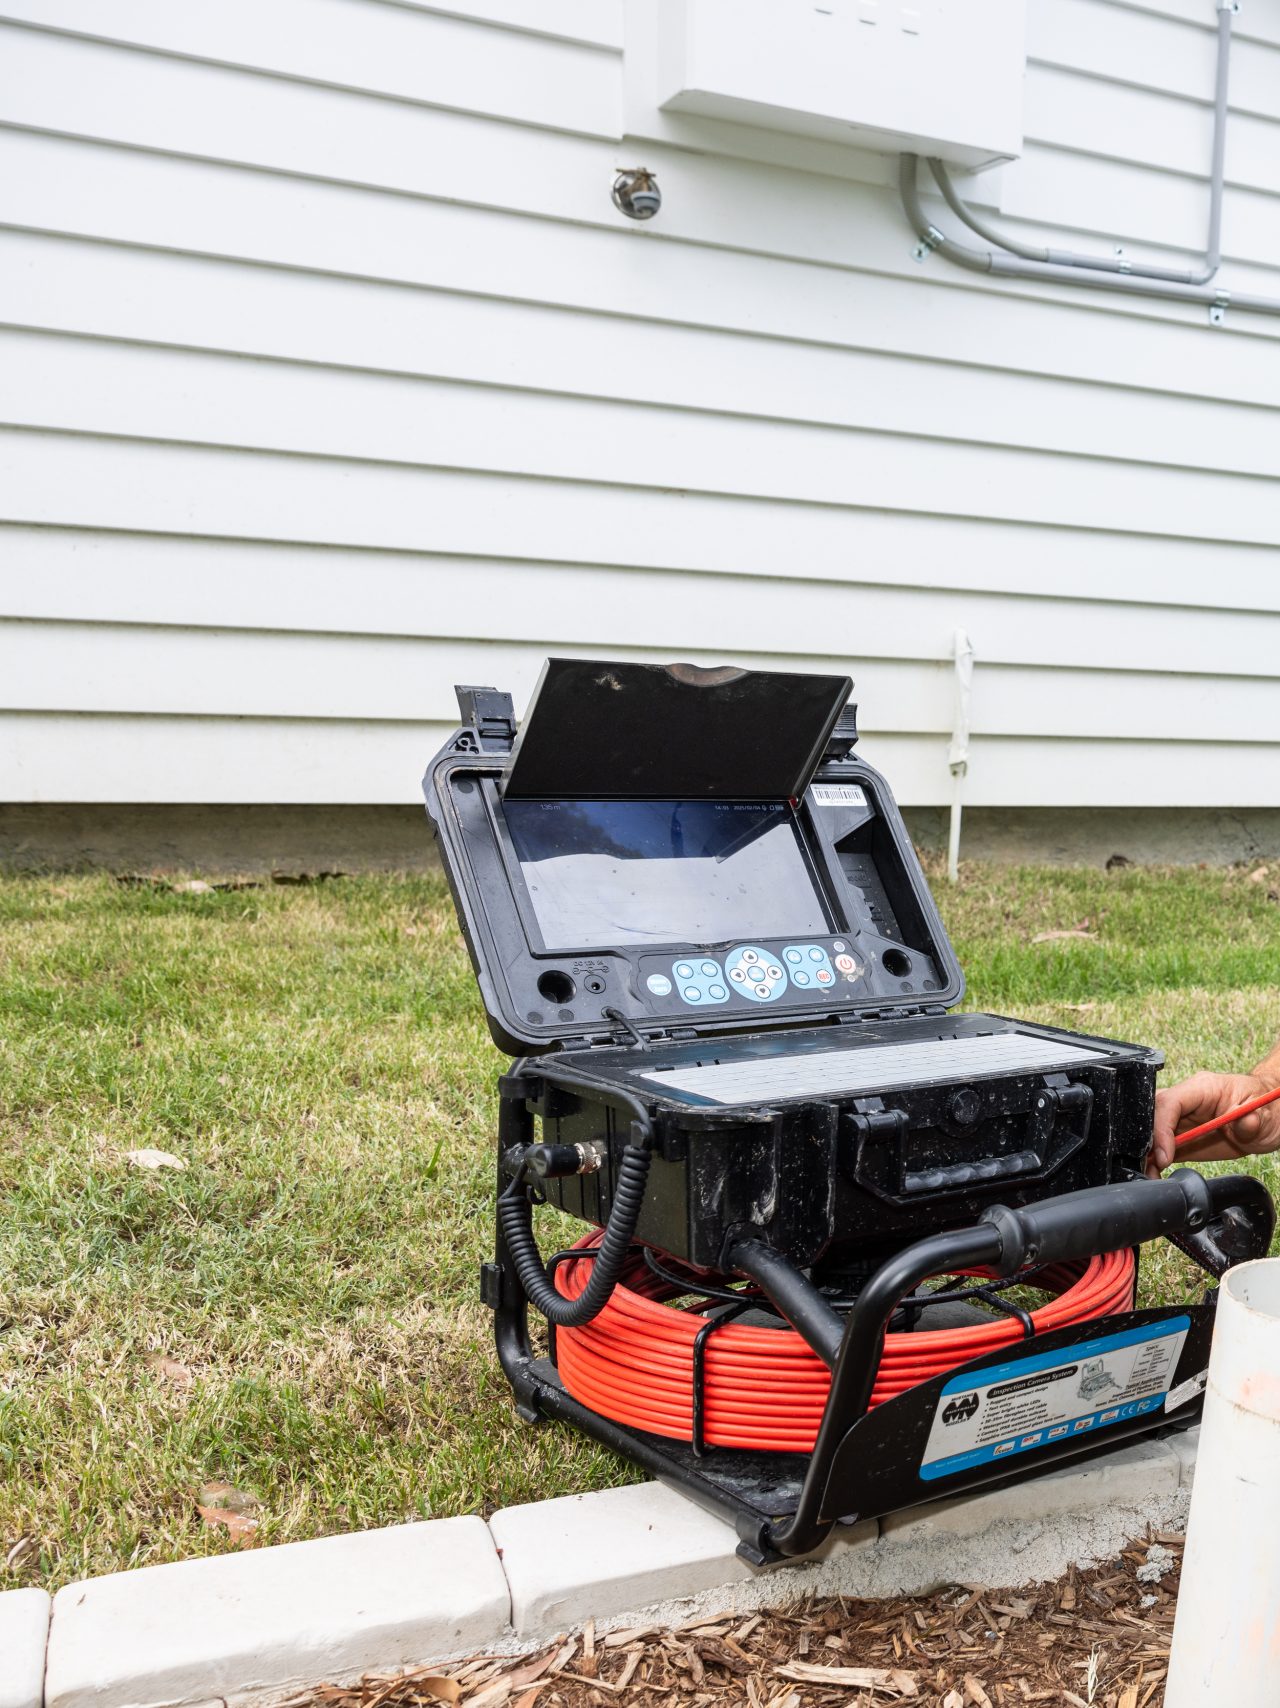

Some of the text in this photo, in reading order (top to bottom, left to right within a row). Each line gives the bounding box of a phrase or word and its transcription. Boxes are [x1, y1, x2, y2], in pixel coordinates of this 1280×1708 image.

[992, 1369, 1074, 1396] Inspection Camera System
